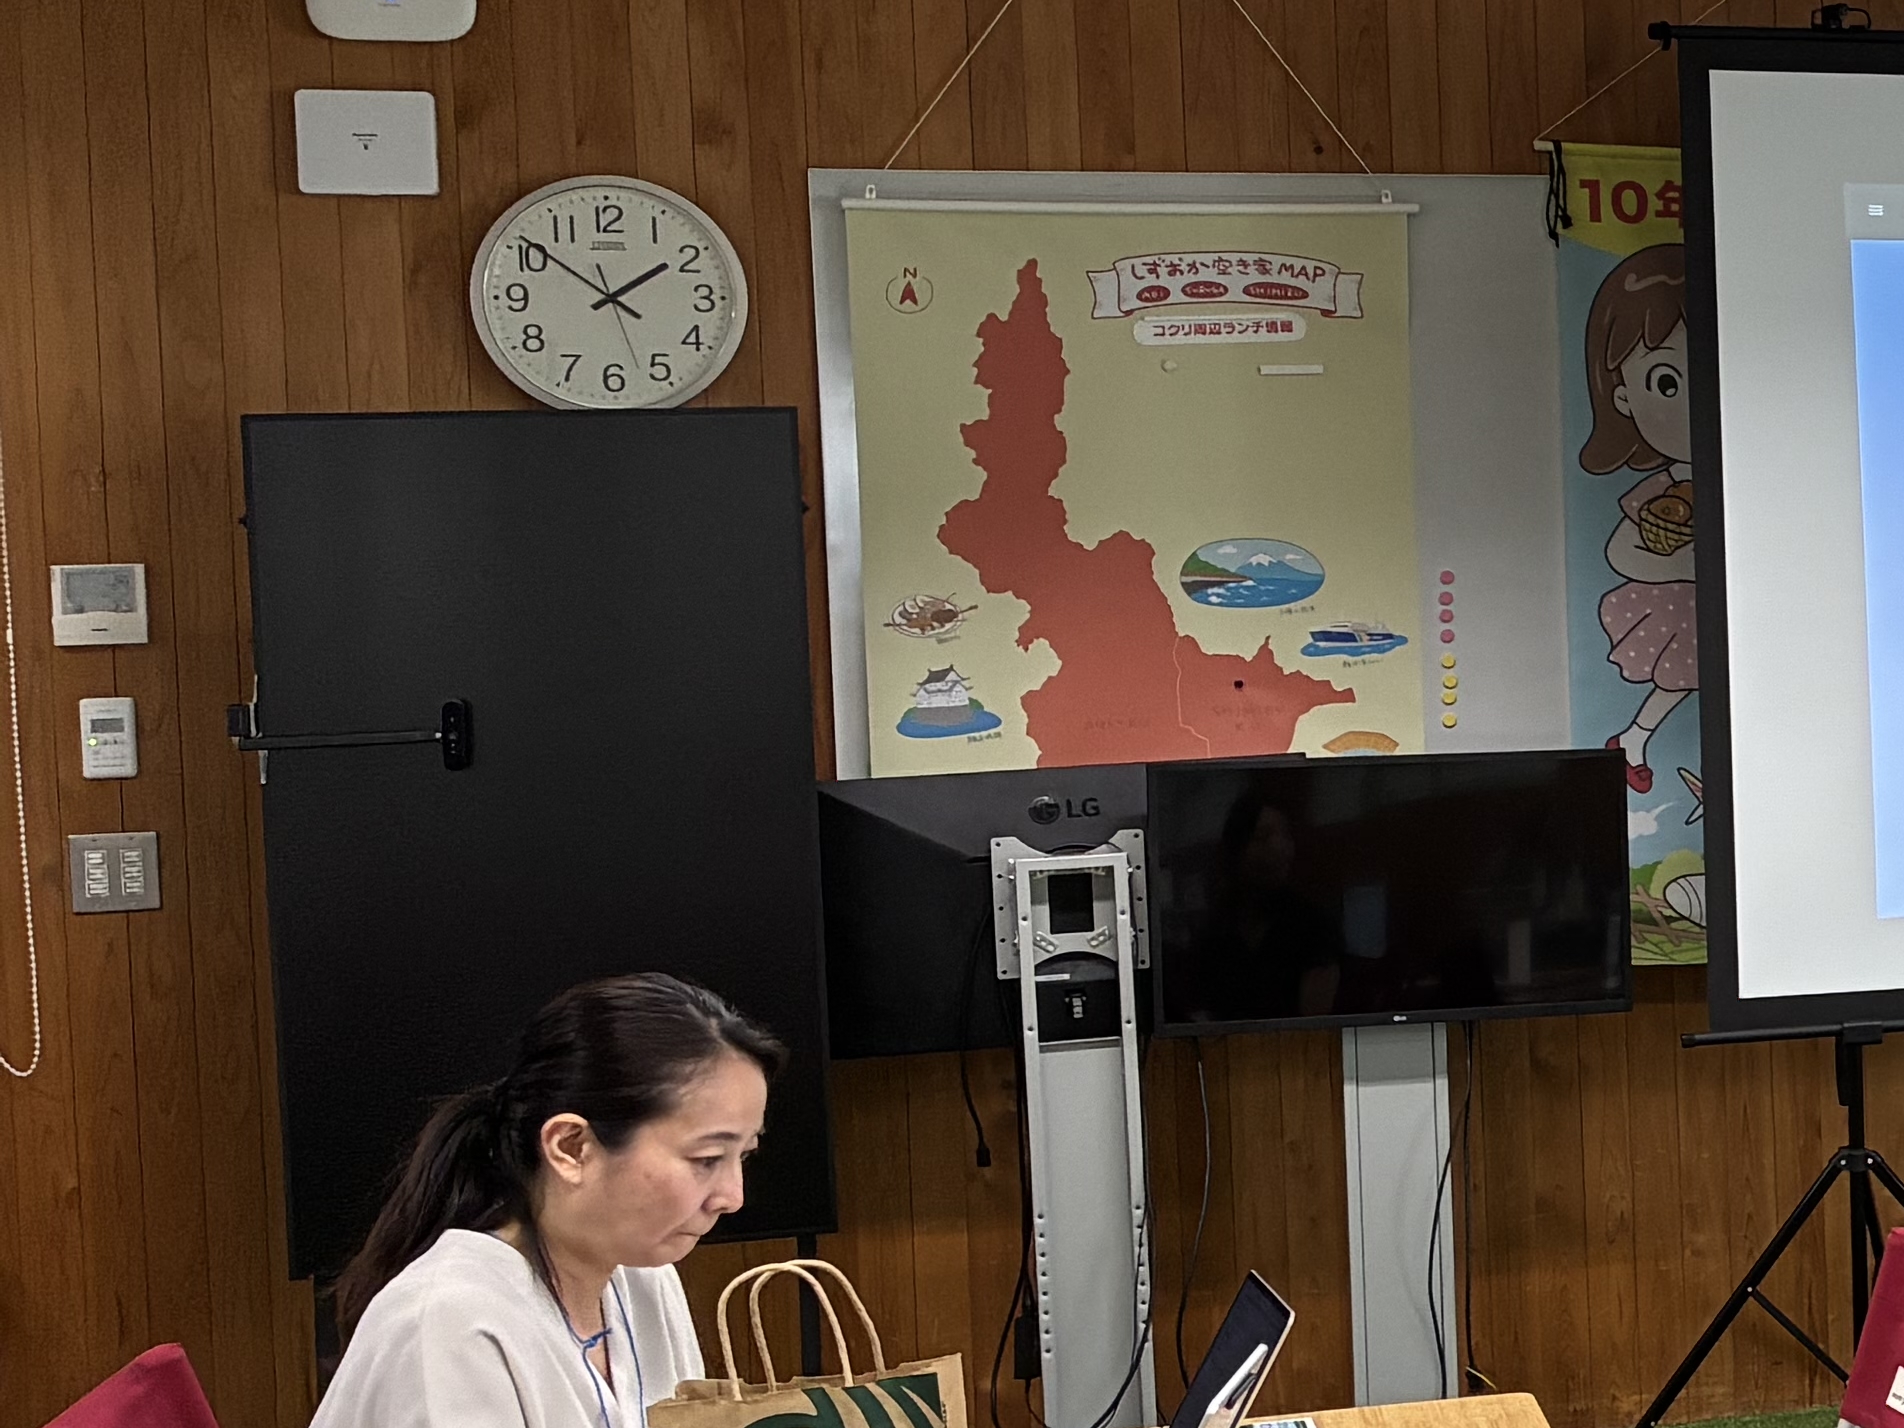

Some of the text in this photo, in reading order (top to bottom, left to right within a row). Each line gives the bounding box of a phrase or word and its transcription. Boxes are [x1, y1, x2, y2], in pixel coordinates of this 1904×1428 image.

[552, 214, 576, 243] 11
[595, 204, 625, 233] 12
[651, 215, 658, 244] 1
[517, 242, 548, 273] 10
[678, 244, 702, 274] 2
[904, 268, 917, 280] N
[505, 283, 530, 313] 9
[692, 283, 716, 313] 3
[521, 323, 545, 353] 8
[681, 324, 704, 352] 4
[559, 353, 583, 383] 7
[602, 363, 626, 393] 6
[648, 352, 672, 382] 5
[1065, 797, 1101, 818] LG
